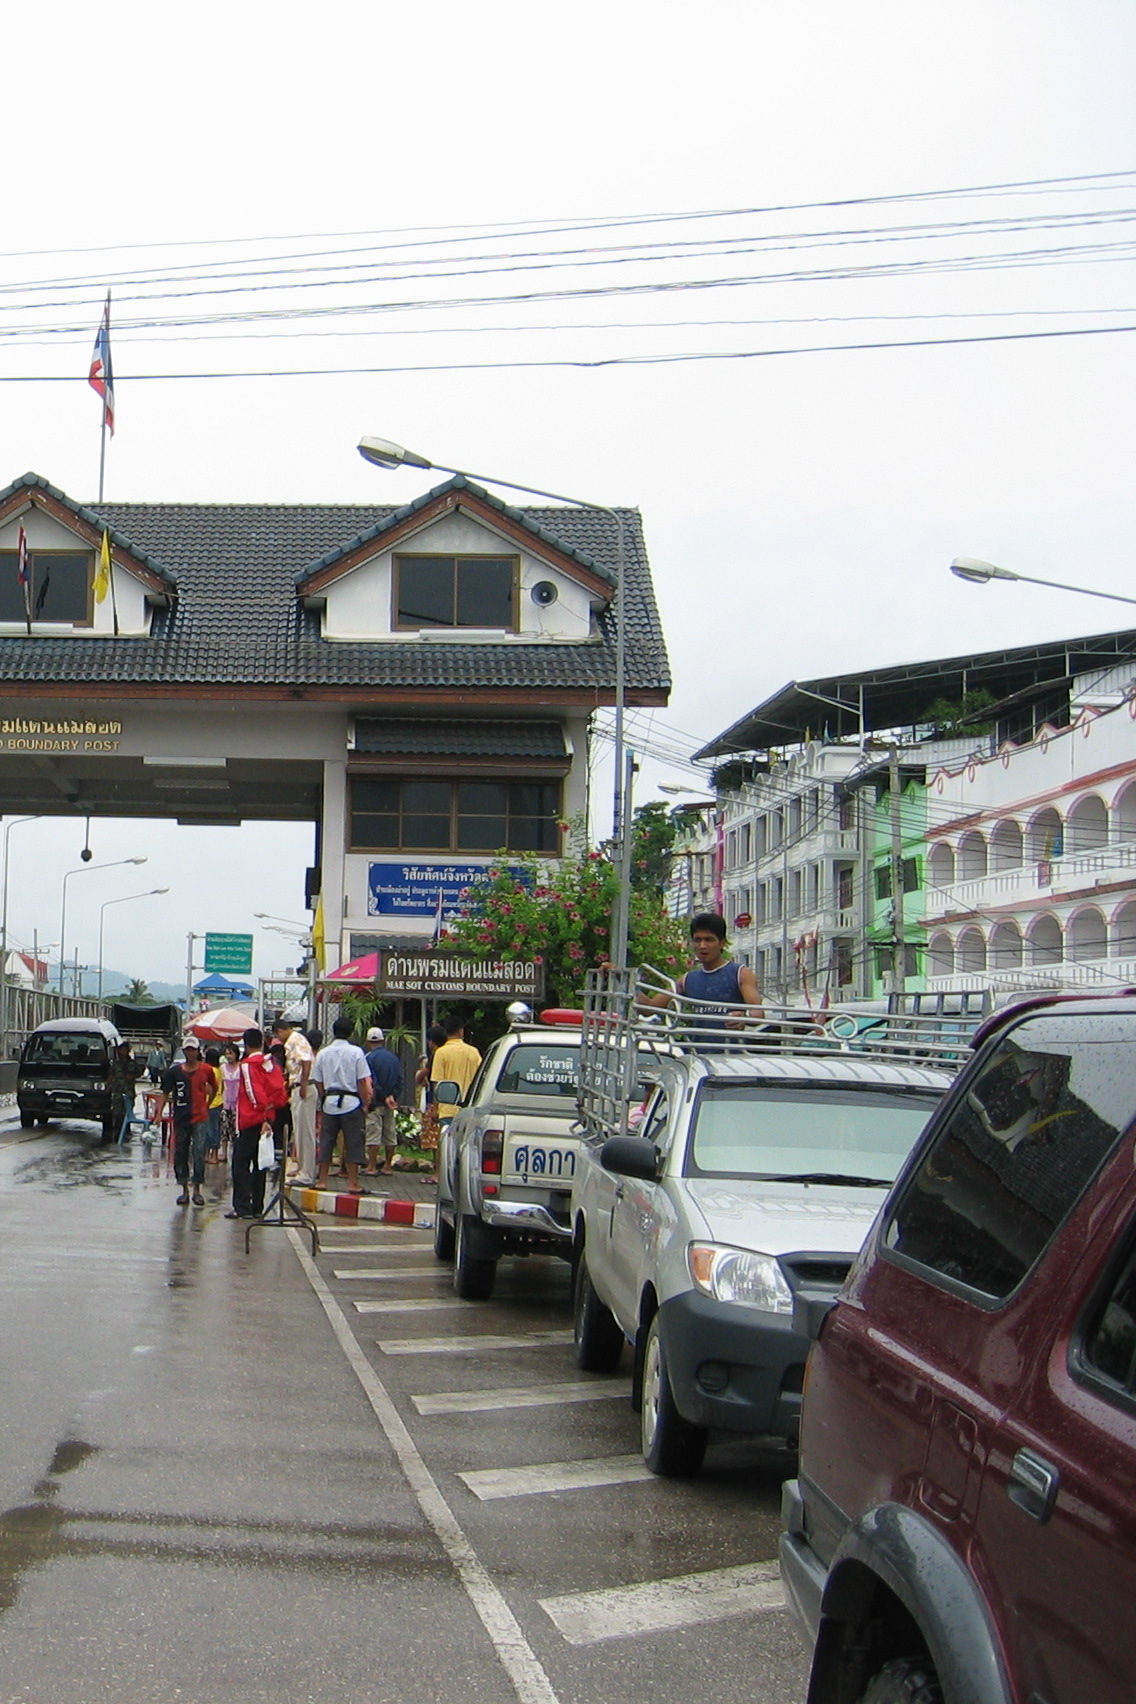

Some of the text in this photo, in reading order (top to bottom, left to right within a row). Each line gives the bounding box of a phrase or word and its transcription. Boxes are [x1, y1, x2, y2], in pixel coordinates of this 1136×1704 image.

[8, 738, 79, 751] BOUNDARY
[84, 740, 120, 752] POST
[386, 981, 537, 994] MAE SOT CUSTOMS BOUNDARY POST
[515, 1145, 576, 1184] ศุลกา
